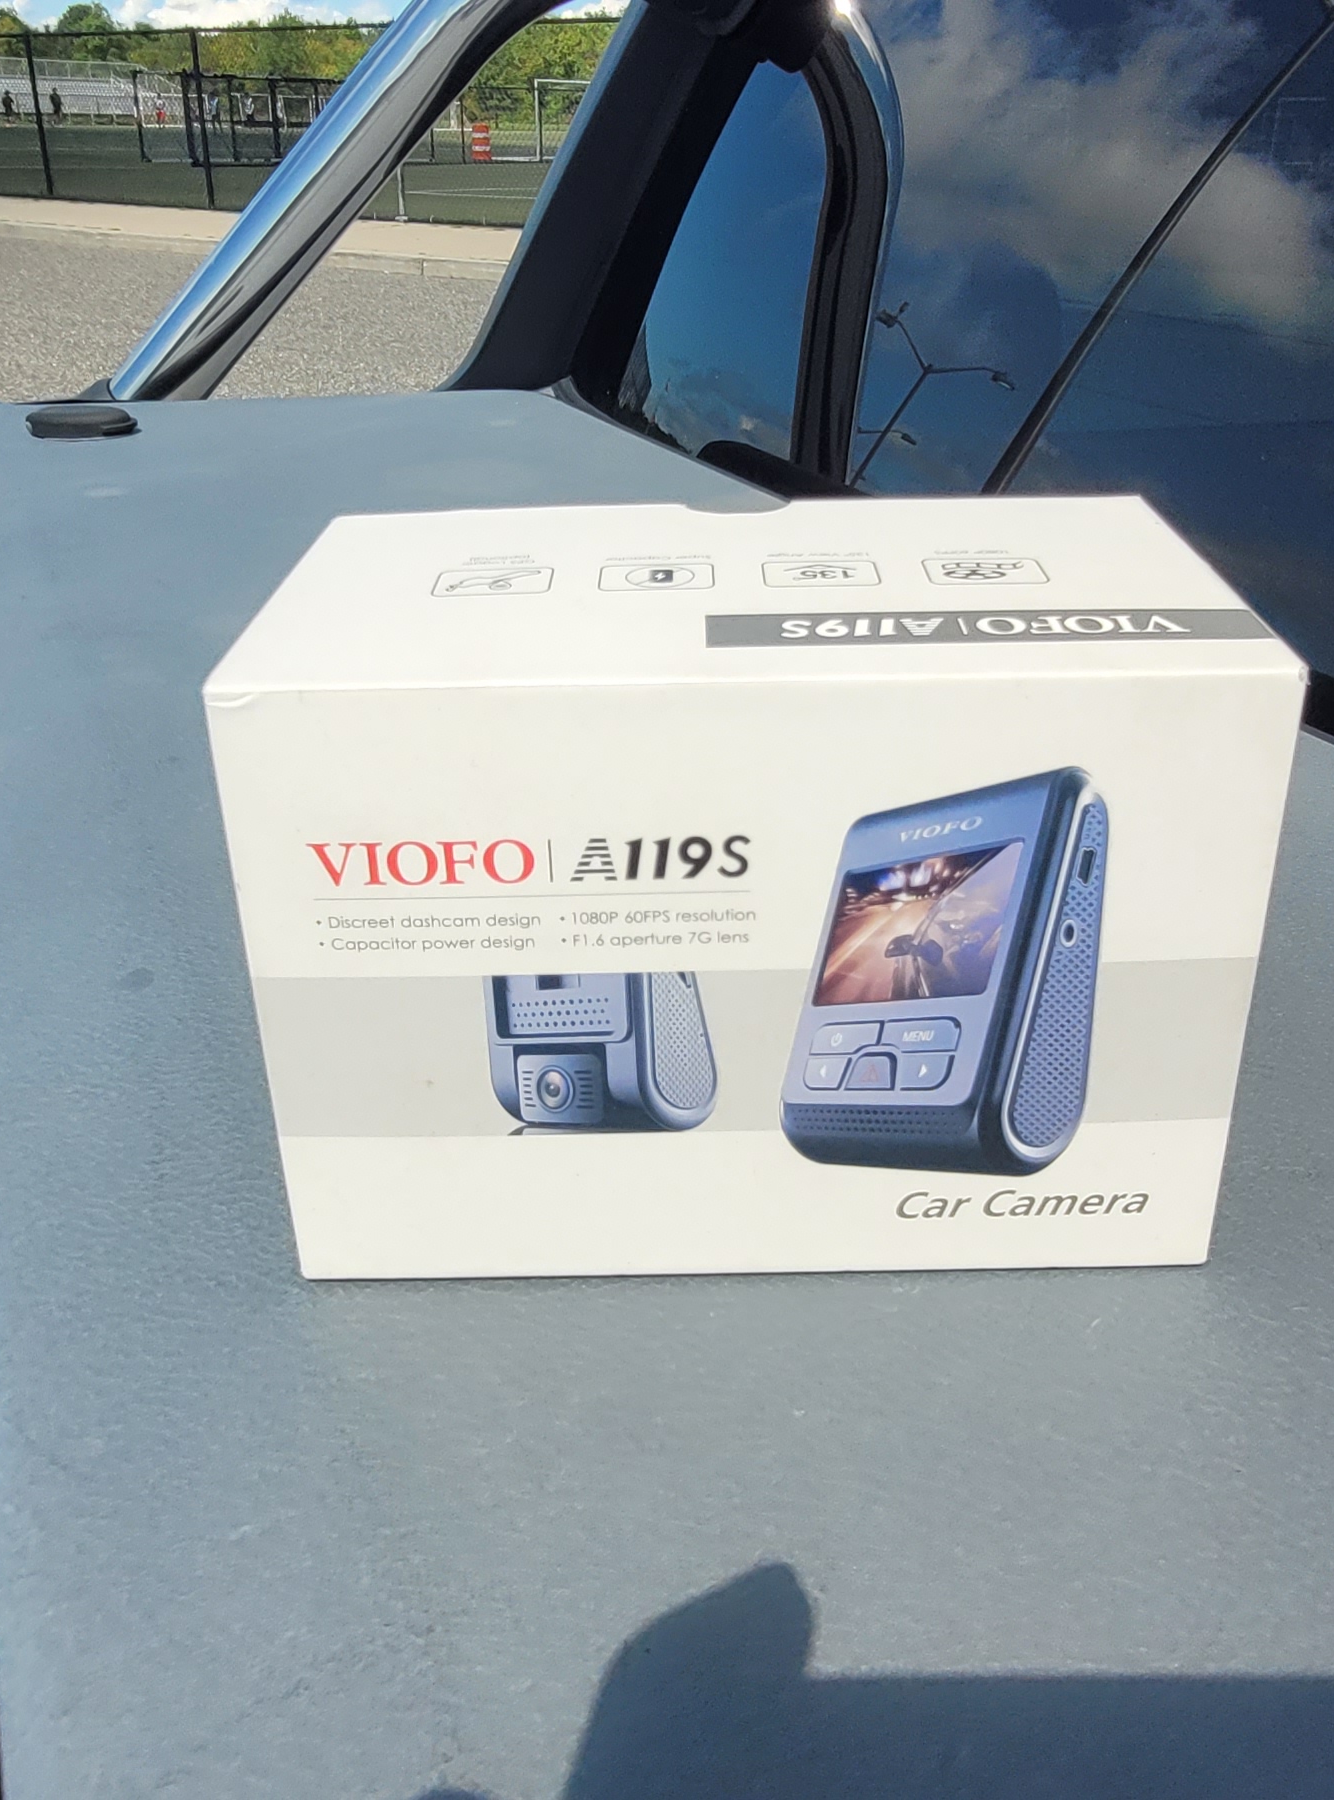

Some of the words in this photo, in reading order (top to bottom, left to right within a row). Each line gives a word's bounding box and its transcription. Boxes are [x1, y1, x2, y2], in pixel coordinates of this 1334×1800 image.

[779, 617, 944, 639] A119S
[975, 615, 1192, 637] VIOFO
[898, 815, 984, 843] VIOFO
[306, 839, 535, 887] VIOFO
[570, 834, 751, 882] A119S
[327, 914, 395, 930] Discreet
[400, 914, 481, 929] dashcam
[486, 912, 542, 930] design
[571, 911, 619, 925] 1080P
[624, 909, 671, 924] 60FPS
[675, 907, 757, 923] resolution
[331, 936, 418, 954] Capacitor
[421, 938, 476, 953] power
[480, 935, 536, 952] design
[572, 933, 605, 947] F1.6
[609, 932, 683, 949] aperture
[689, 931, 712, 945] 7G
[716, 930, 750, 944] lens
[901, 1029, 935, 1043] MENU
[895, 1191, 971, 1220] Car
[982, 1189, 1150, 1218] Camera
